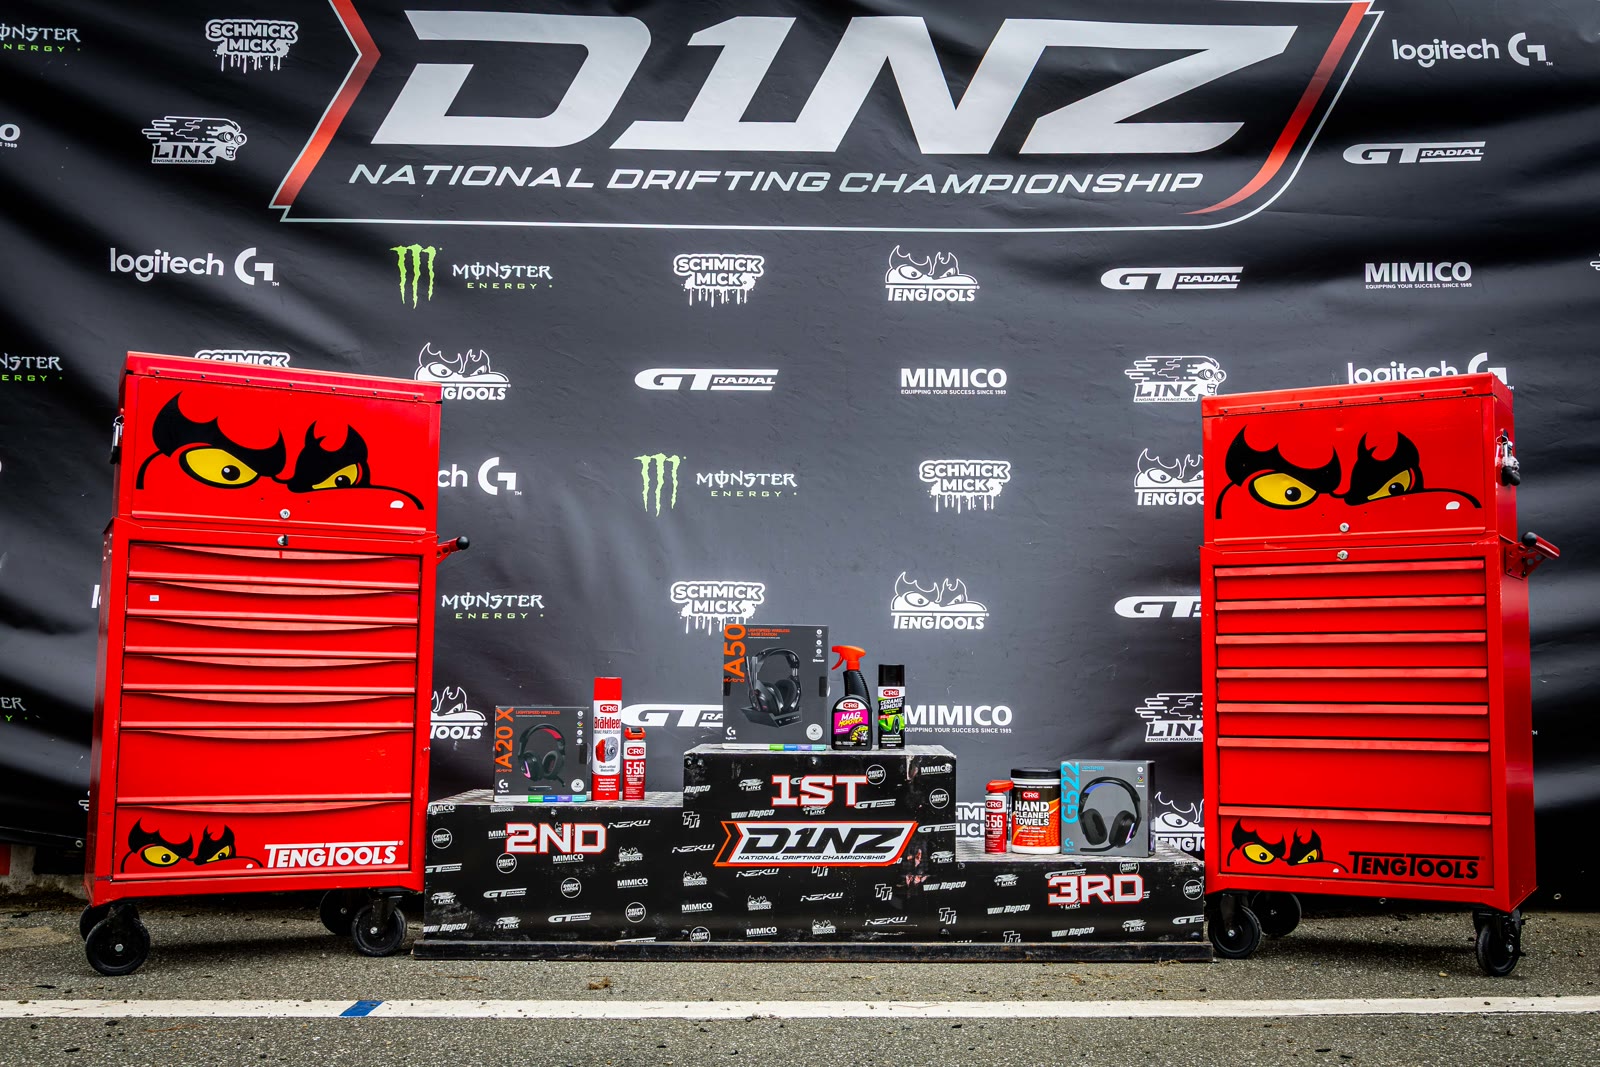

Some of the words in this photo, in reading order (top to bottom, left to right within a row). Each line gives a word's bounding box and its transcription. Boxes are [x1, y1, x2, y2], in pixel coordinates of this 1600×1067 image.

[0, 24, 81, 42] ONSTER
[211, 23, 294, 39] SCHMICK
[3, 44, 65, 52] NERGY
[229, 39, 276, 52] MICK
[1391, 38, 1501, 68] logitech
[371, 10, 1298, 154] D1NZ
[153, 145, 217, 159] LINK
[1342, 142, 1420, 164] GT
[1420, 148, 1484, 157] RADIAL
[348, 164, 594, 189] NATIONAL
[606, 168, 832, 192] DRIFTING
[839, 172, 1204, 194] CHAMPIONSHIP
[110, 247, 225, 282] logitech
[452, 262, 554, 280] MONSTER
[677, 258, 761, 272] SCHMICK
[696, 272, 742, 286] MICK
[1100, 267, 1178, 290] GT
[1178, 275, 1241, 283] RADIAL
[1365, 261, 1472, 283] MIMICO
[467, 282, 538, 290] ENERGY
[0, 352, 63, 371] NSTER
[634, 368, 712, 391] GT
[712, 376, 776, 385] RADIAL
[901, 368, 1008, 388] MIMICO
[1135, 384, 1198, 397] LINK
[923, 463, 1007, 479] SCHMICK
[696, 470, 798, 488] MONSTER
[941, 479, 991, 492] MICK
[675, 585, 761, 600] SCHMICK
[441, 591, 545, 610] MONSTER
[693, 600, 743, 613] MICK
[1114, 596, 1201, 618] GT
[455, 612, 529, 620] ENERGY
[723, 624, 746, 678] A50
[621, 704, 701, 727] GT
[841, 712, 860, 720] MAG
[904, 705, 1012, 726] MIMICO
[1148, 723, 1203, 736] LIN
[494, 726, 513, 768] A20
[626, 762, 644, 774] 5-56
[684, 785, 711, 793] Repco
[772, 775, 868, 807] 1ST
[1061, 761, 1079, 823] G522
[748, 809, 775, 818] Repco
[1015, 801, 1050, 812] HAND
[986, 815, 1003, 828] 5-56
[1015, 811, 1050, 819] CLEANER
[1015, 818, 1050, 826] TOWELS
[506, 823, 606, 854] 2ND
[740, 828, 905, 853] D1NZ
[553, 854, 583, 862] MIMICO
[617, 878, 648, 887] MIMICO
[940, 881, 966, 890] Repco
[1047, 874, 1143, 905] 3RD
[682, 903, 713, 911] MIMICO
[1004, 904, 1030, 913] Repco
[440, 923, 467, 932] Repco
[746, 927, 778, 936] MIMICO
[1068, 927, 1095, 936] Repco
